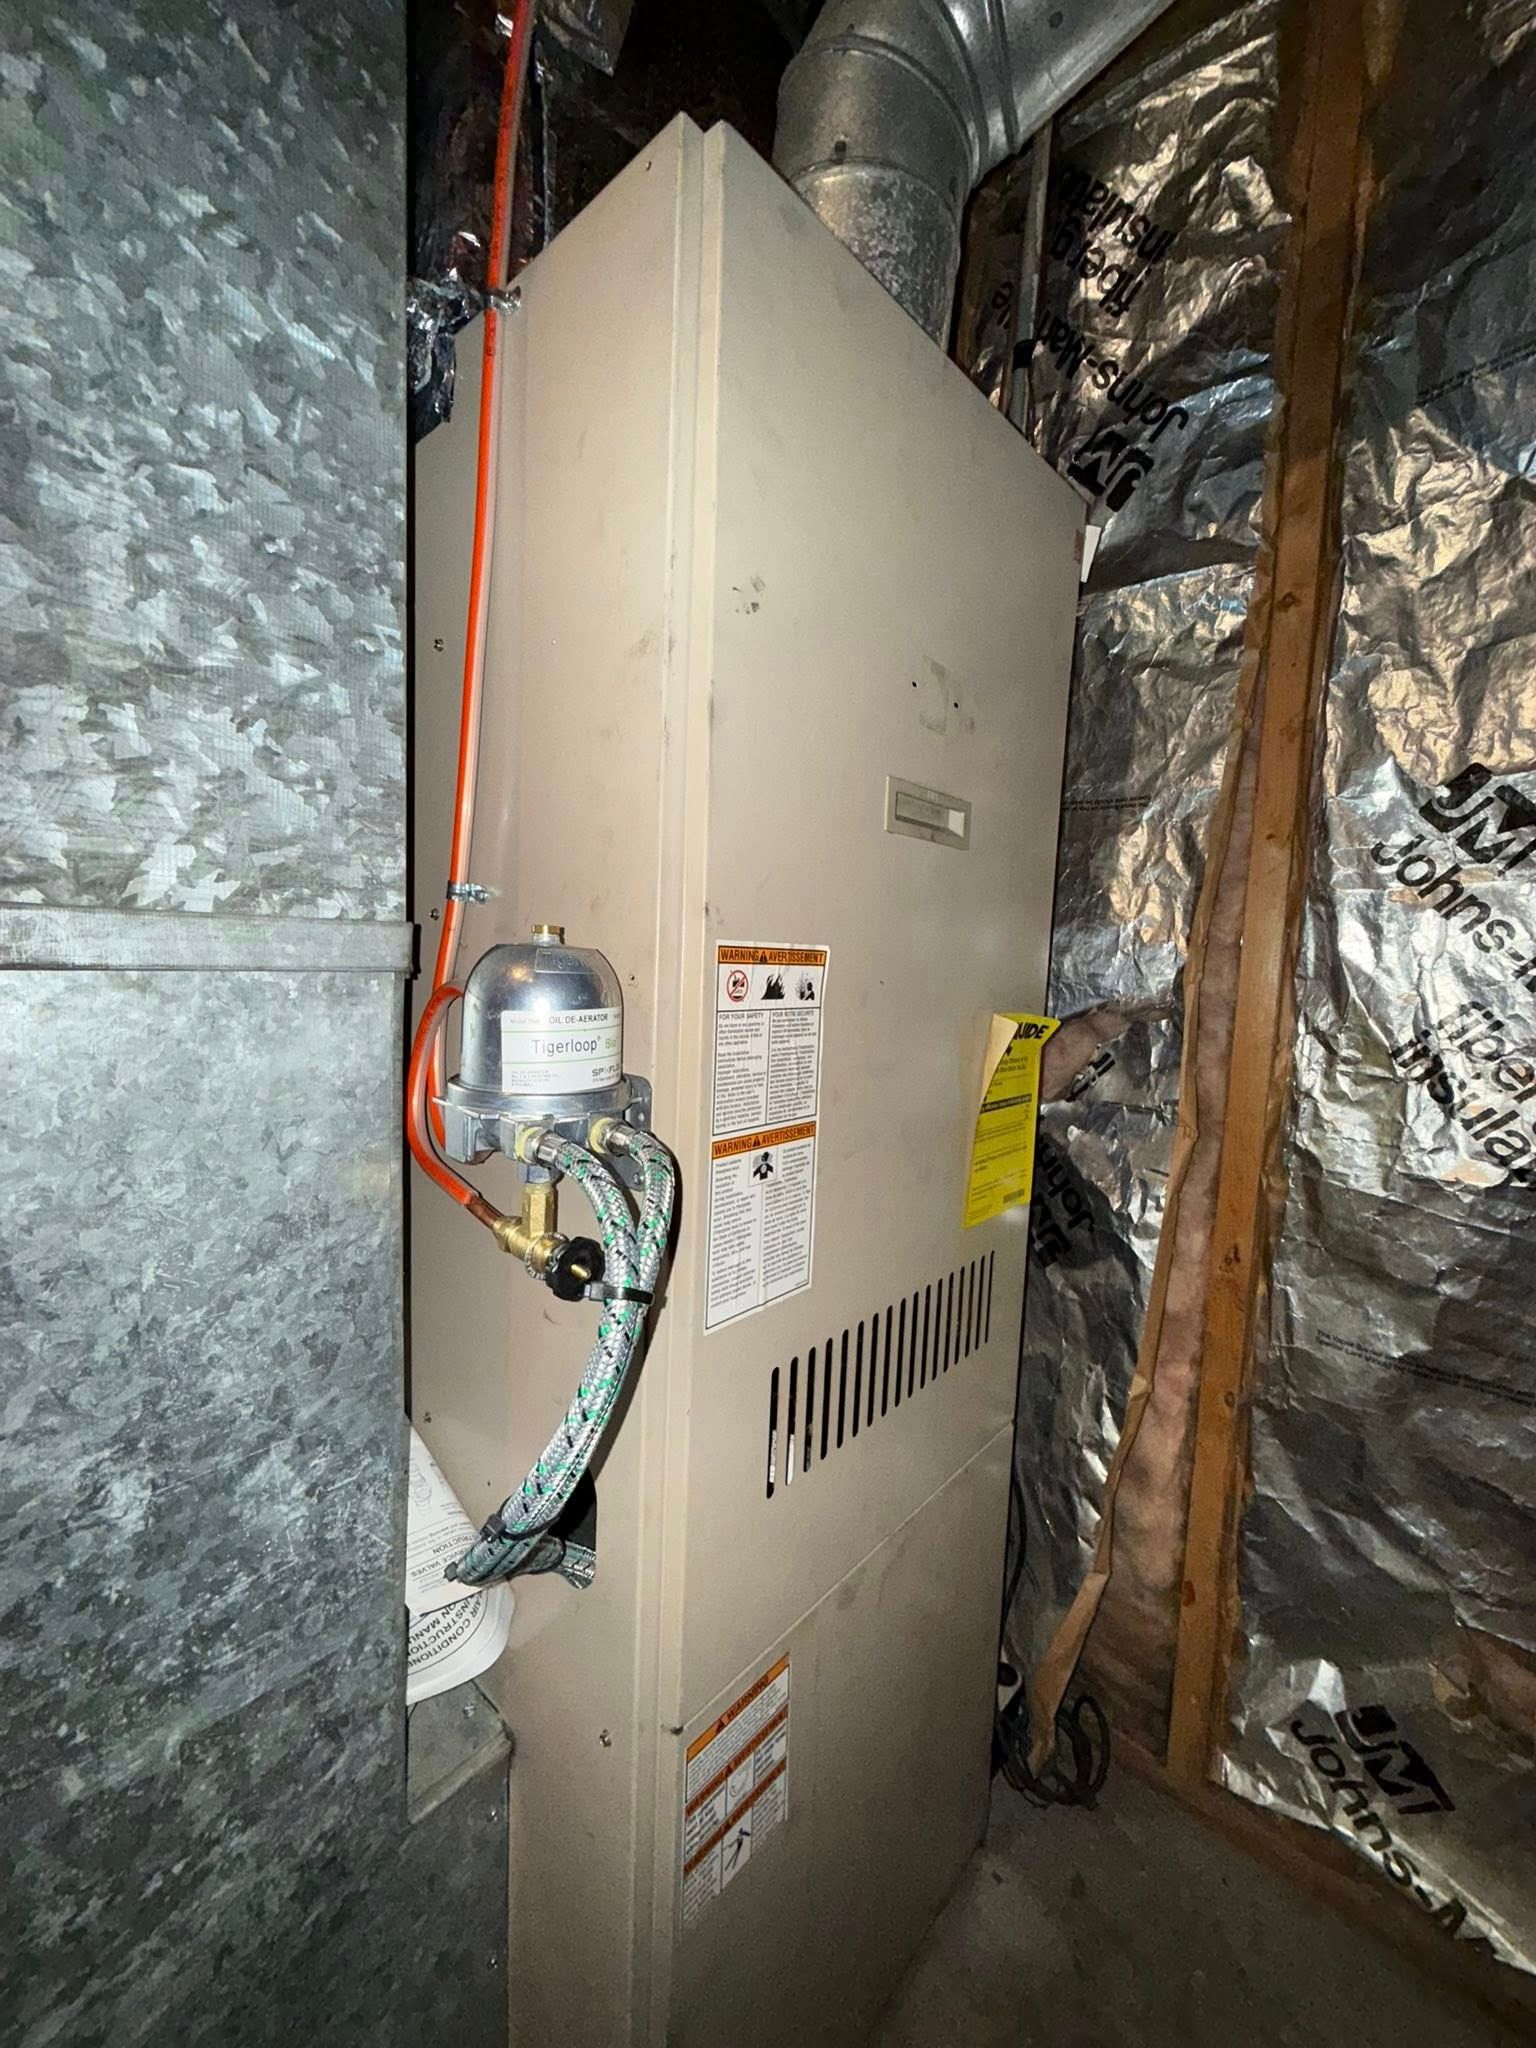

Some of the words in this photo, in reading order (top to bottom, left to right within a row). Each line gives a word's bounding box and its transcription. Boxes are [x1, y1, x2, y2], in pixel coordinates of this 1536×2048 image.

[1066, 430, 1155, 513] JM
[1418, 762, 1536, 877] JM
[720, 949, 759, 961] WARNING
[768, 951, 824, 963] AVERTISSEMENT
[548, 1015, 562, 1024] OIL
[731, 1012, 745, 1020] YOUR
[1013, 1021, 1049, 1040] UIDE
[714, 1137, 752, 1155] WARNING
[760, 1124, 814, 1145] AVERTISSEMENT
[410, 1560, 441, 1578] VALVES
[407, 1598, 473, 1657] INSTRUCTIO
[1333, 1704, 1456, 1815] JM
